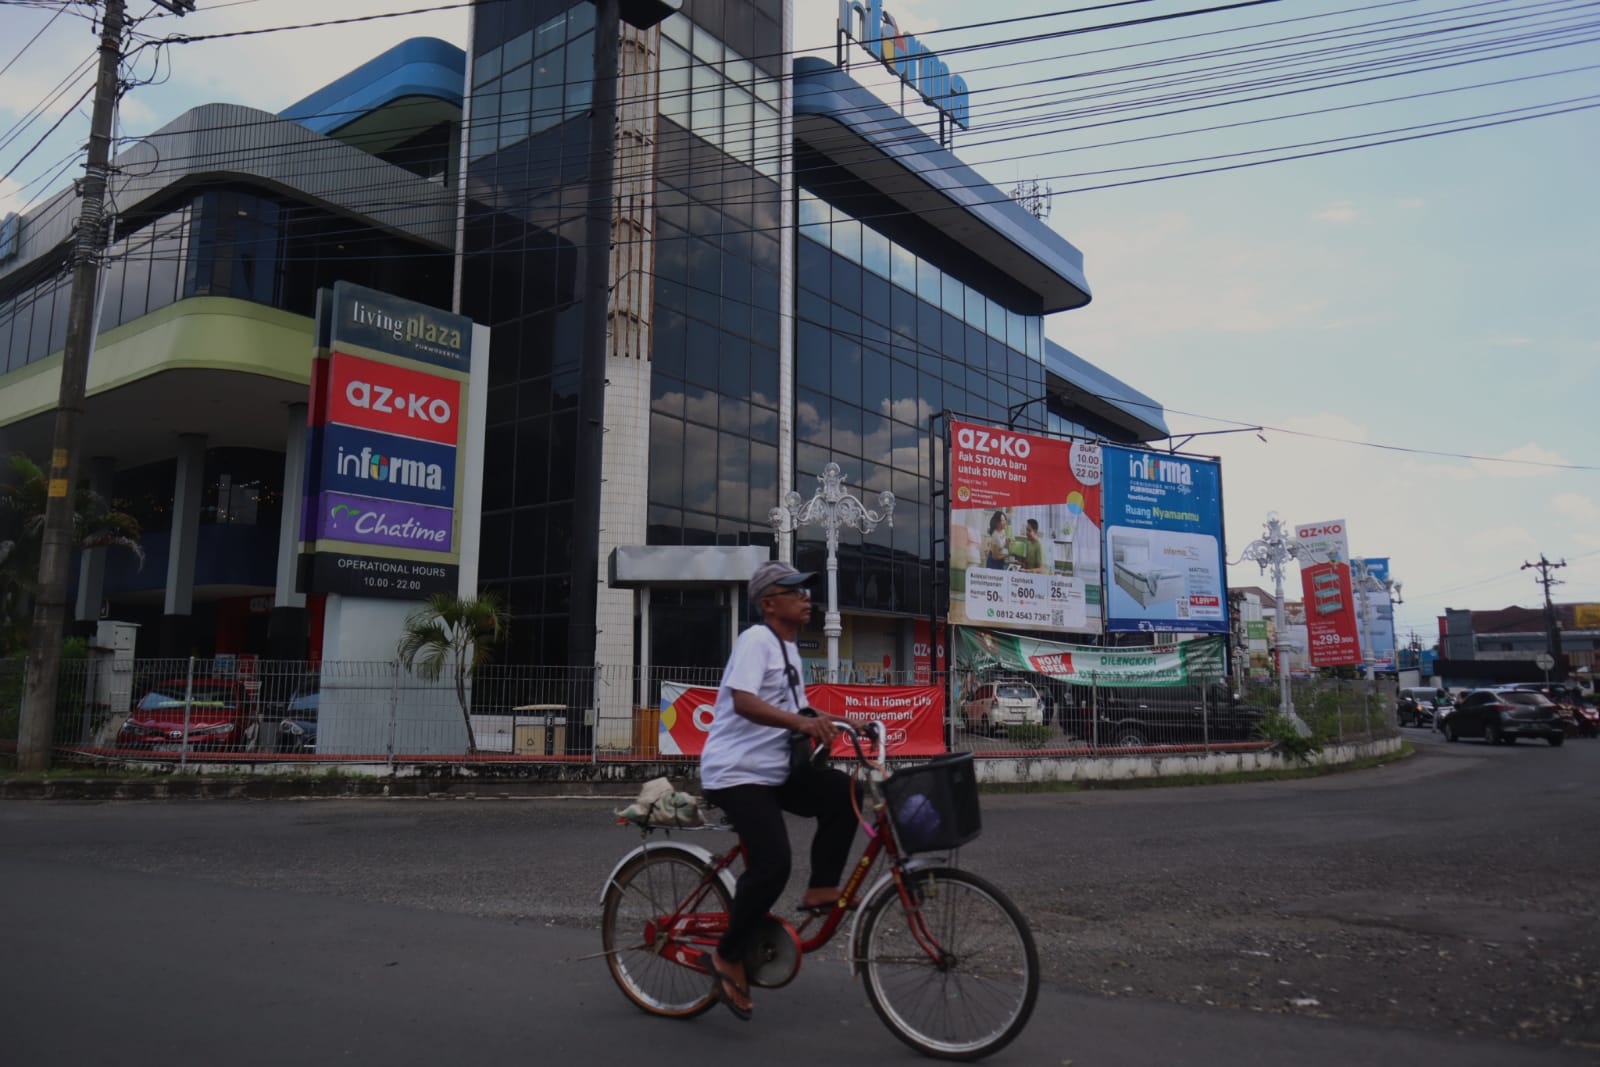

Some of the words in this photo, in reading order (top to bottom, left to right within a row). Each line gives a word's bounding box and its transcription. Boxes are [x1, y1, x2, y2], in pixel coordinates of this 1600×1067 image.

[353, 301, 403, 342] living
[406, 315, 462, 350] plaza
[976, 454, 1008, 468] STORA
[1009, 459, 1028, 472] baru
[1077, 454, 1099, 465] 10.00
[338, 446, 443, 491] informa
[982, 467, 1008, 479] STORY
[1009, 471, 1028, 483] baru
[1076, 468, 1099, 479] 22.00
[1129, 454, 1192, 485] informa
[1125, 504, 1151, 519] Ruang
[355, 511, 447, 543] Chatime
[338, 557, 411, 575] OPERATIONAL
[412, 563, 447, 578] HOURS
[364, 576, 389, 589] 10.00
[397, 579, 422, 591] 22.00
[1018, 587, 1034, 599] 600
[1037, 655, 1063, 665] NOW
[1101, 656, 1156, 665] DILENGKAPI
[1040, 664, 1068, 673] OPEN
[845, 696, 861, 706] No.
[864, 696, 868, 706] 1
[882, 696, 911, 707] Home
[845, 710, 914, 721] Improvement
